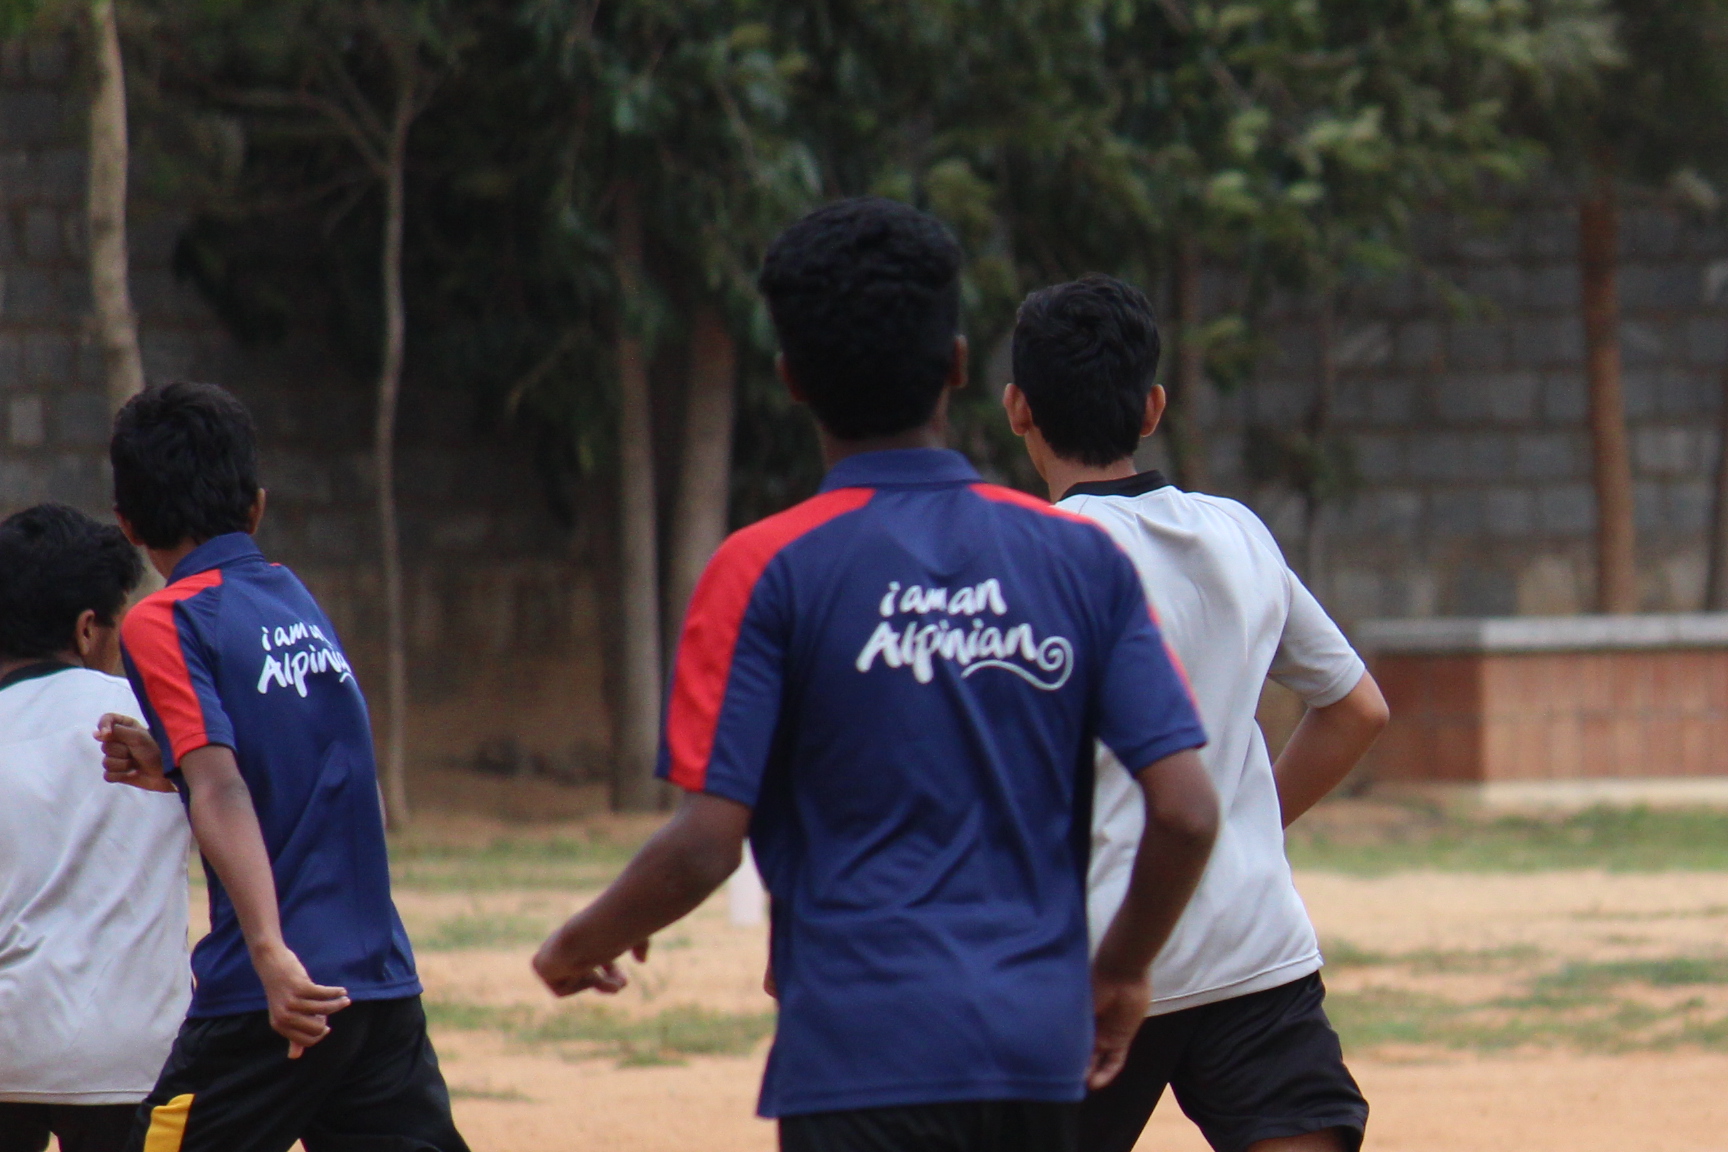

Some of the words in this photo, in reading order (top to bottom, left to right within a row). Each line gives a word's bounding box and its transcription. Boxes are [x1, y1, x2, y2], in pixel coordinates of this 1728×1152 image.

[274, 621, 308, 647] am
[855, 618, 1038, 684] Alpinian
[257, 645, 352, 698] Alpinia
